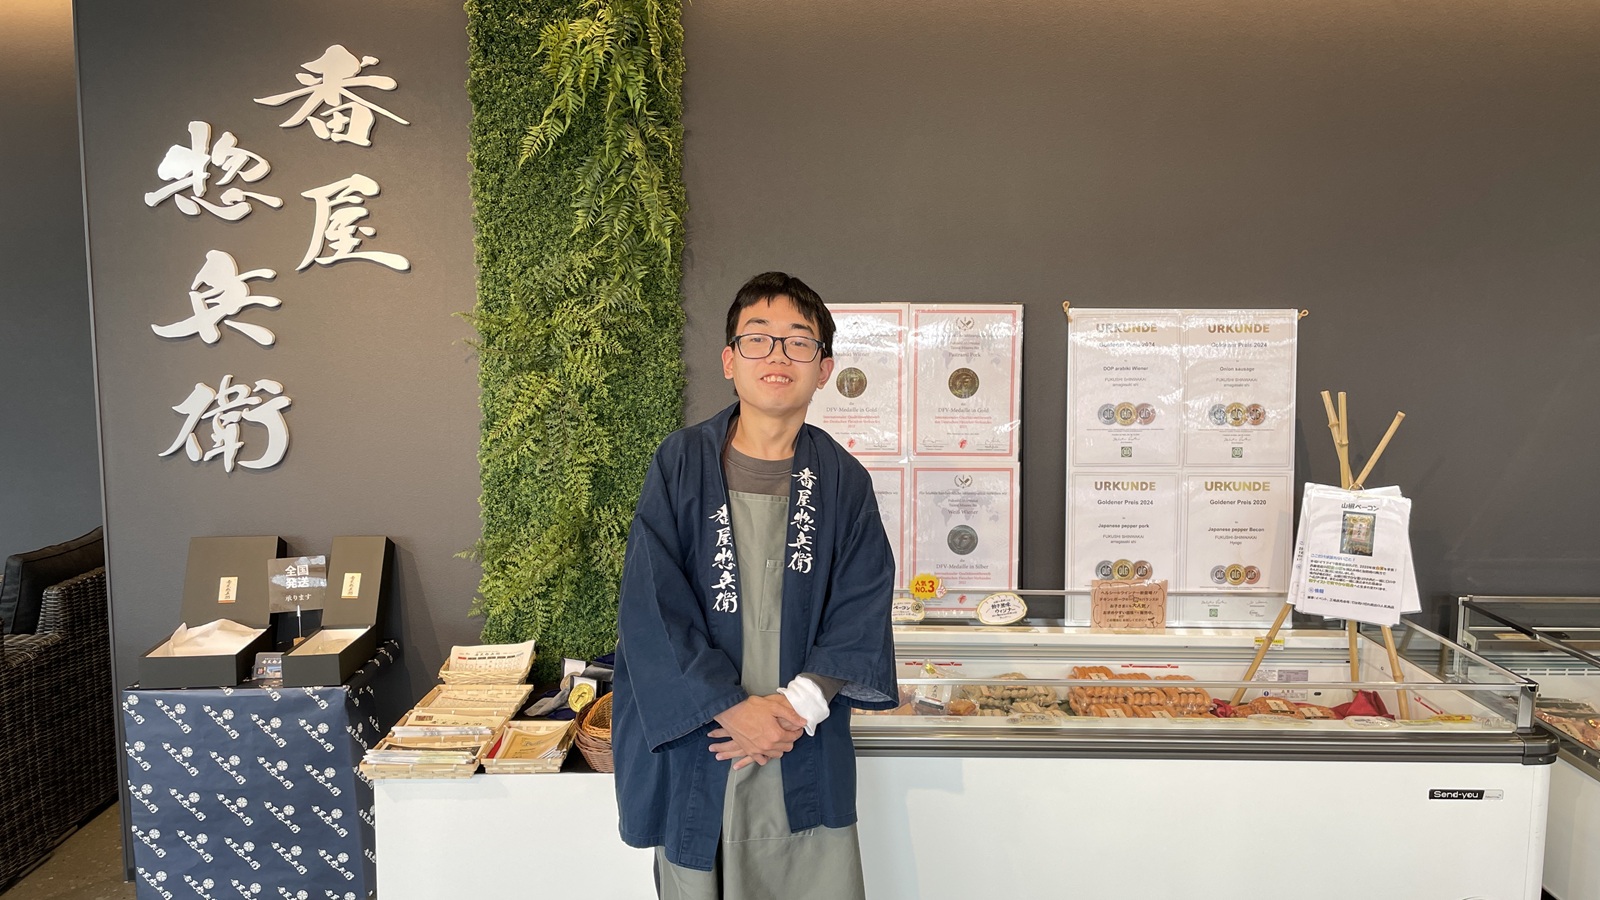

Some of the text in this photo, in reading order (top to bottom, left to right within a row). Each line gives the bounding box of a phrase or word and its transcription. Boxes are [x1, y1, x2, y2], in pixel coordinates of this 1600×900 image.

[253, 44, 411, 272] 番屋
[144, 120, 292, 473] 惣兵衛
[1208, 324, 1270, 333] URKUNDE
[1094, 481, 1156, 491] URKUNDE
[1204, 481, 1271, 491] URKUNDE
[285, 565, 309, 577] 全国
[285, 576, 310, 589] 発送
[285, 594, 312, 602] 承ります
[1433, 790, 1479, 799] Send-you
